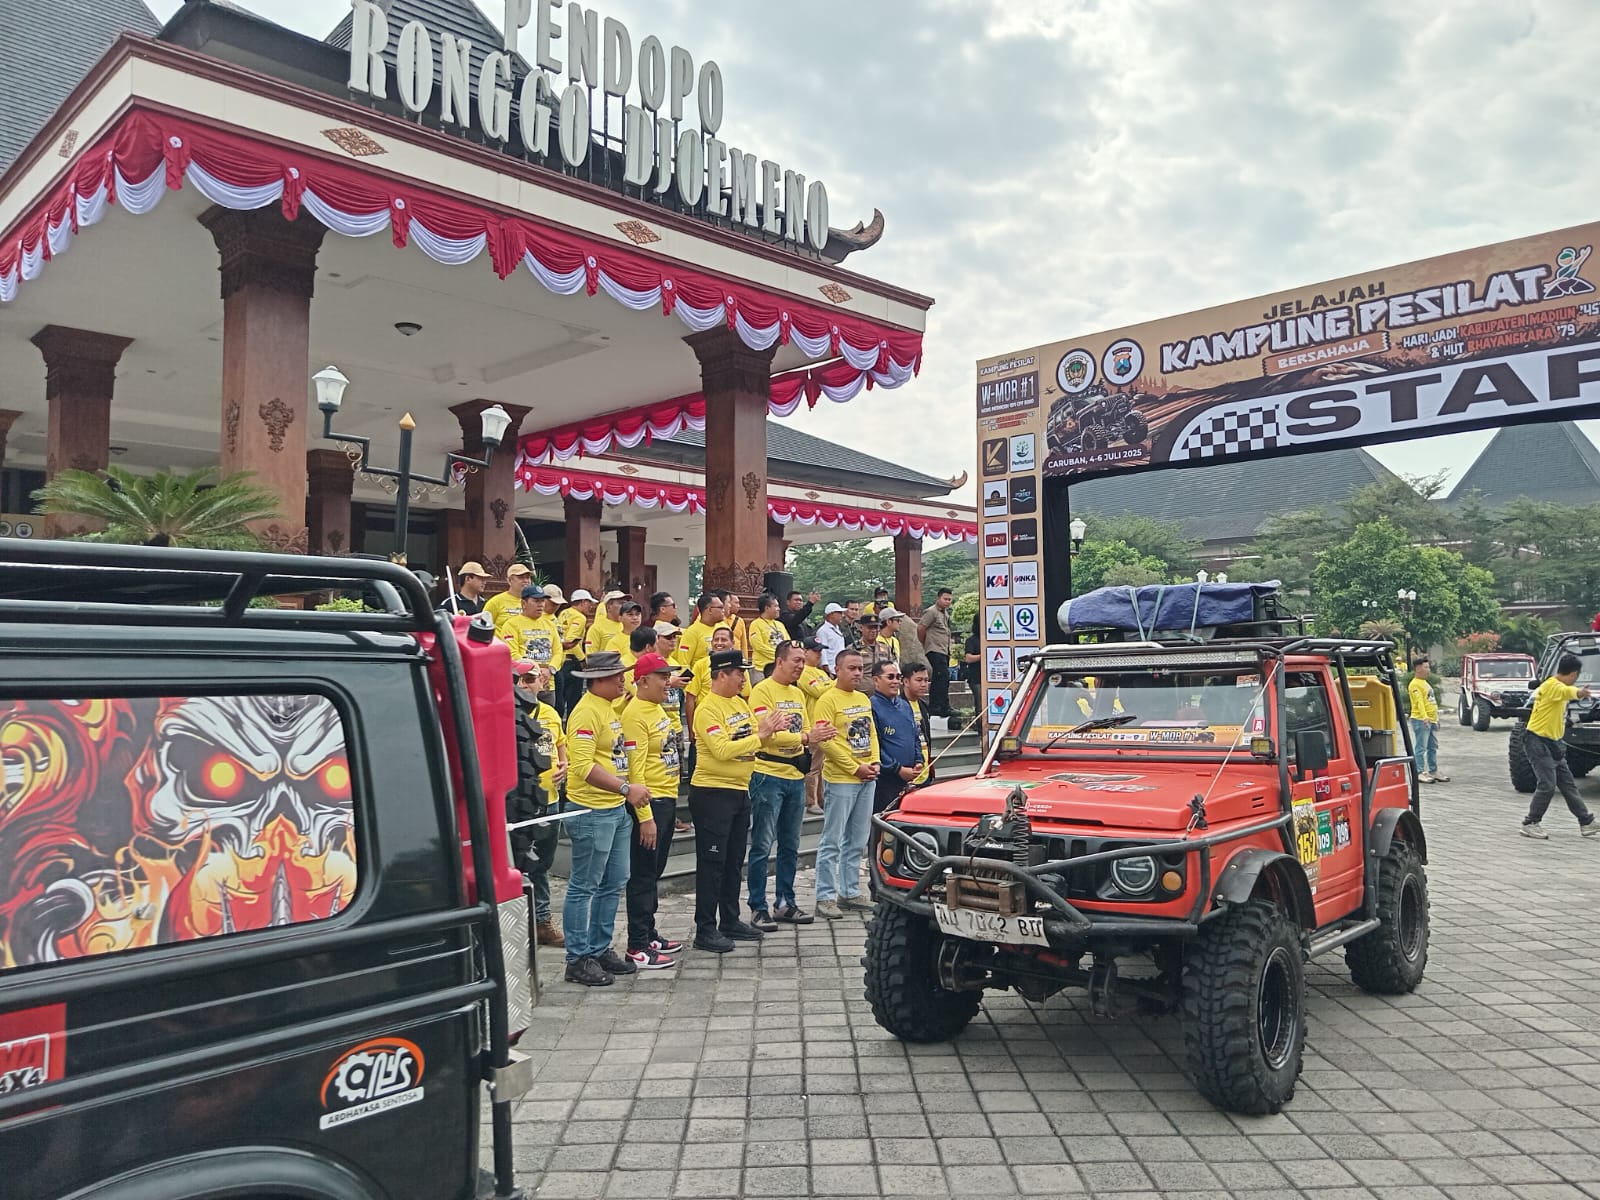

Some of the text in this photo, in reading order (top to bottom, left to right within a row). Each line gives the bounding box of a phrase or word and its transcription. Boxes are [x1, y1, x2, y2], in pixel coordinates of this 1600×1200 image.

[503, 0, 724, 135] PENDOPO
[347, 0, 829, 250] RONGGO DJOEMENO
[1263, 281, 1385, 319] JELAJAH
[1161, 266, 1548, 372] KAMPUNG PESILAT
[1403, 331, 1428, 348] HARI
[1431, 328, 1457, 342] JADI
[1460, 316, 1527, 338] KABUPATEN
[1528, 307, 1576, 327] MADIUN
[1277, 338, 1370, 369] BERSAHAJA
[1431, 346, 1440, 358] &
[1443, 342, 1465, 356] HUT
[1467, 328, 1554, 352] BHAYANGKARA
[981, 379, 1018, 406] W-MOR
[1020, 375, 1034, 398] #1
[1048, 449, 1142, 469] CARUBAN, 4-6 JULI 2025
[327, 1091, 418, 1125] ARDHAYASA SENTOSA
